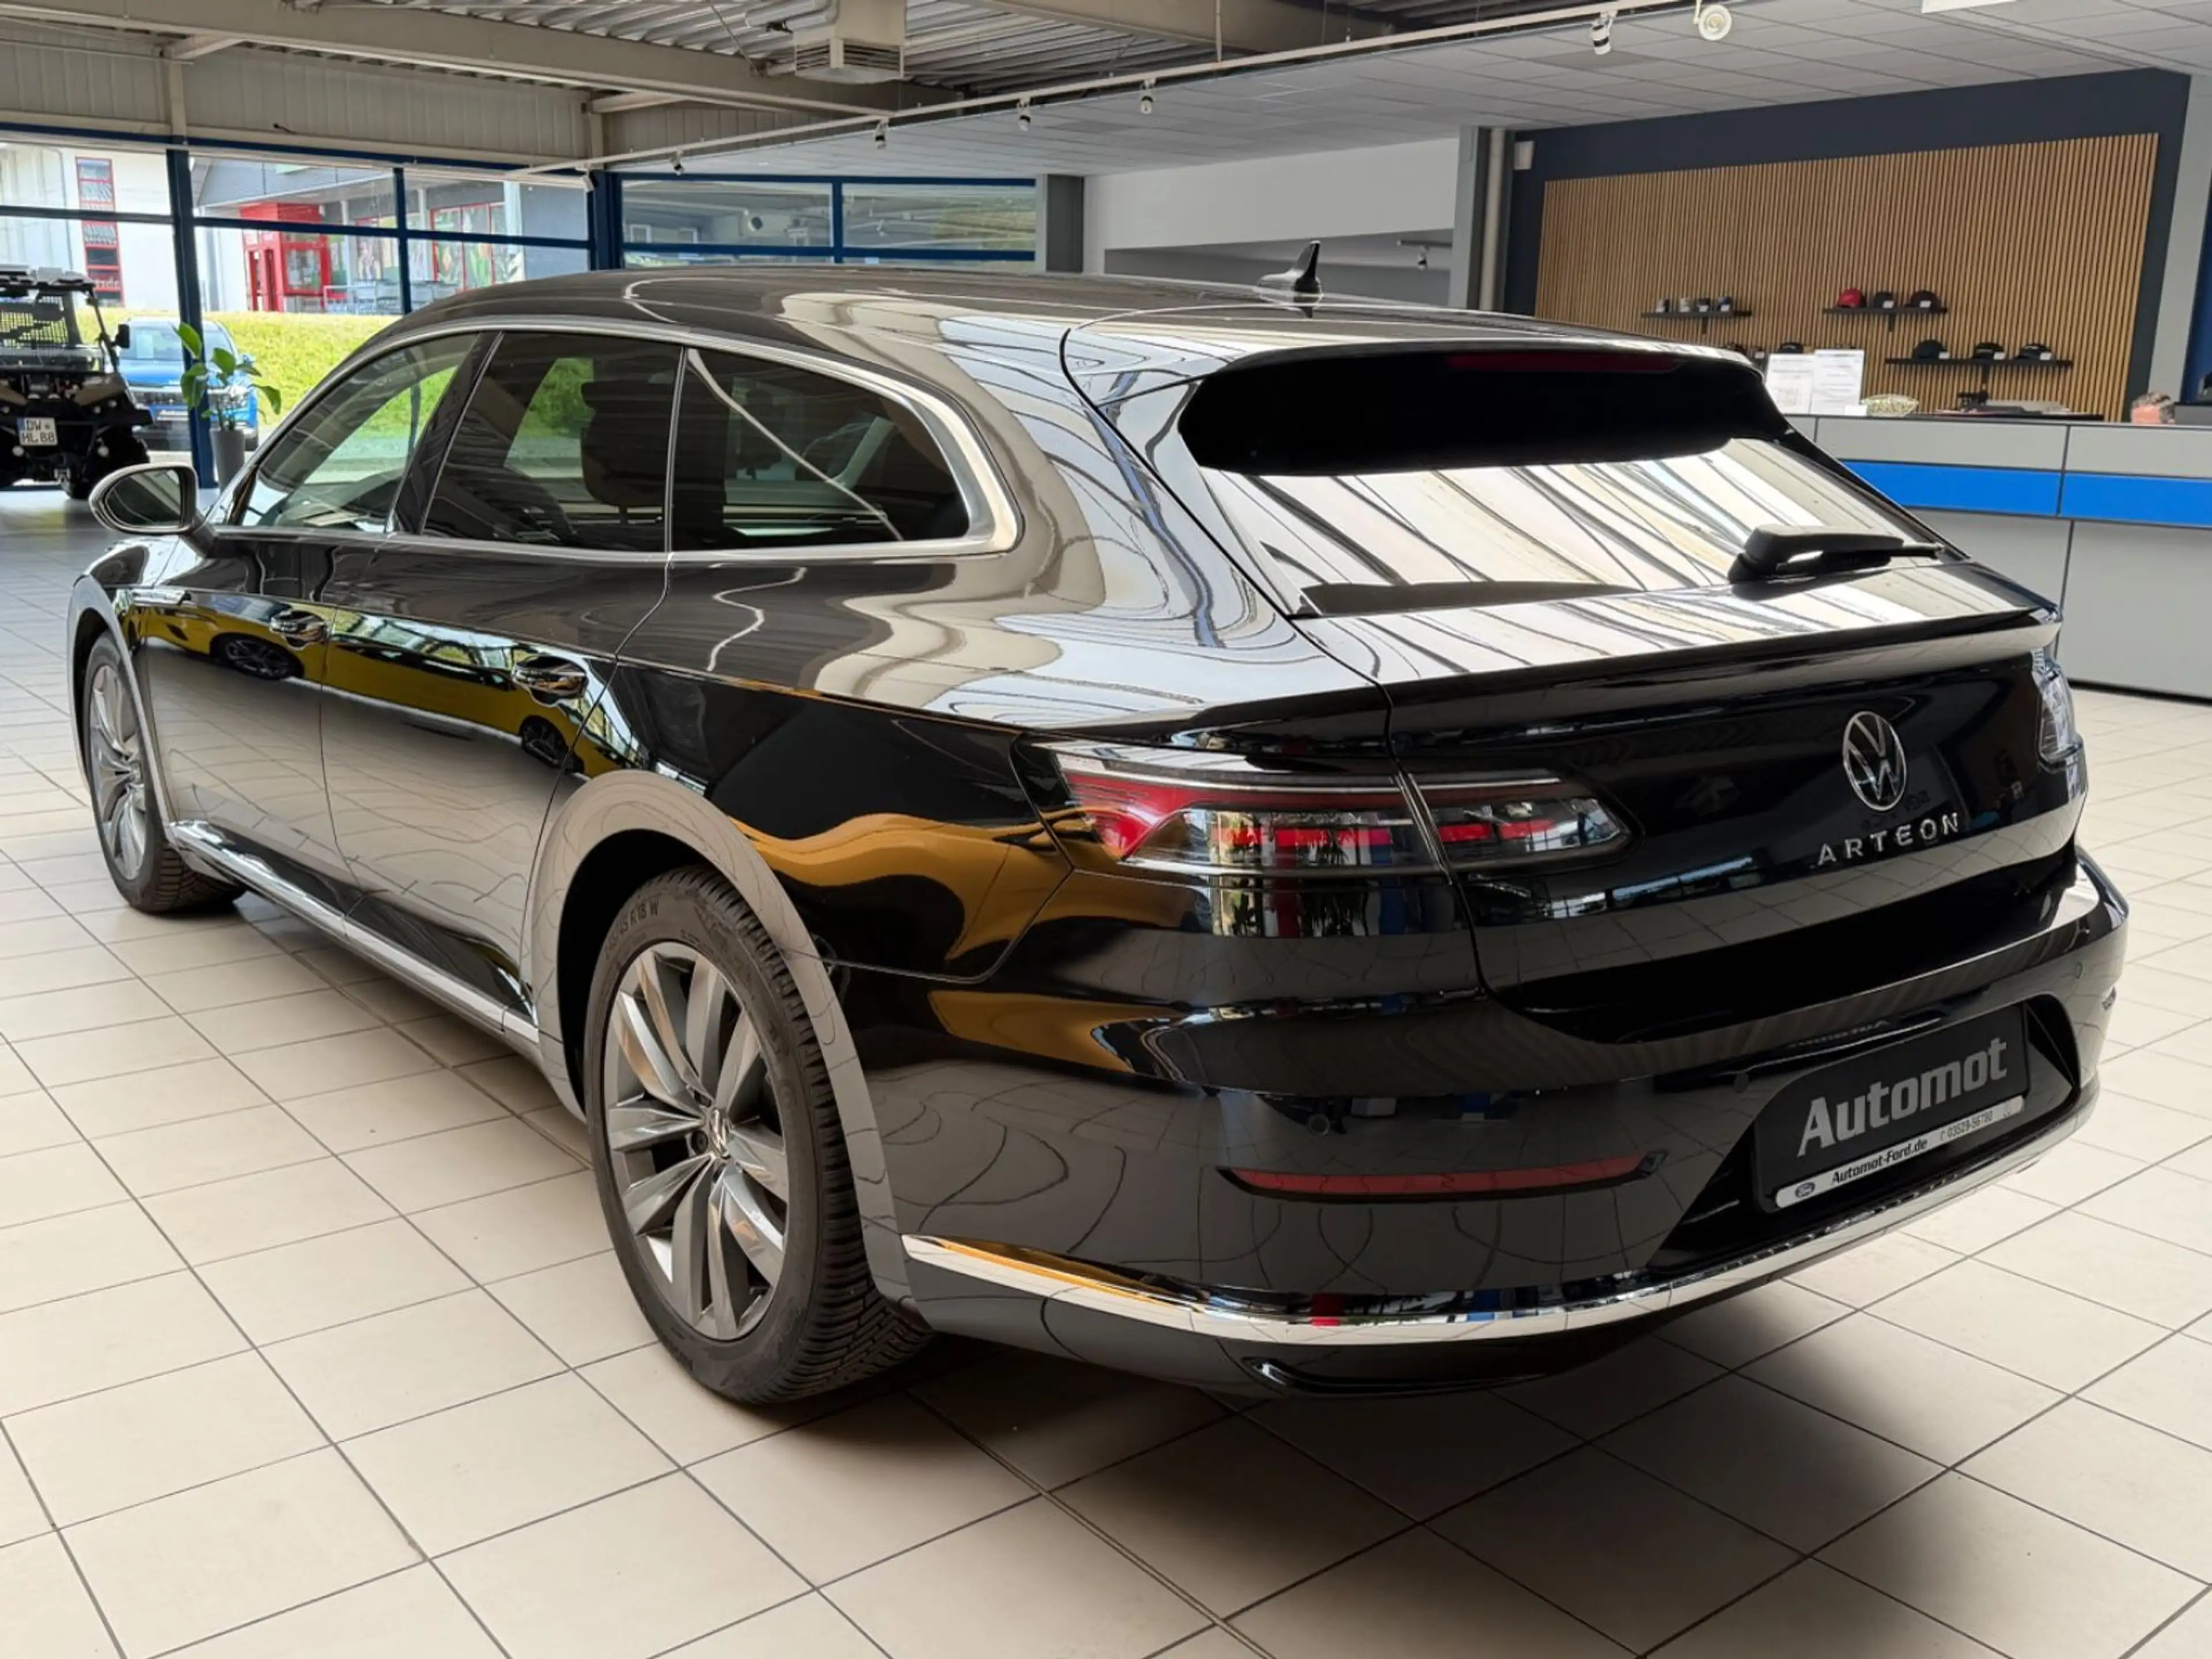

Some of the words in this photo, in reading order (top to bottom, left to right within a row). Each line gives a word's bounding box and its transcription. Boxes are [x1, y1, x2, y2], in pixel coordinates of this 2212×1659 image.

[26, 421, 41, 431] DW
[1817, 812, 1959, 866] ARTEON
[1796, 1036, 2008, 1158] Automot
[1830, 1138, 1928, 1185] Automot-Ford.de
